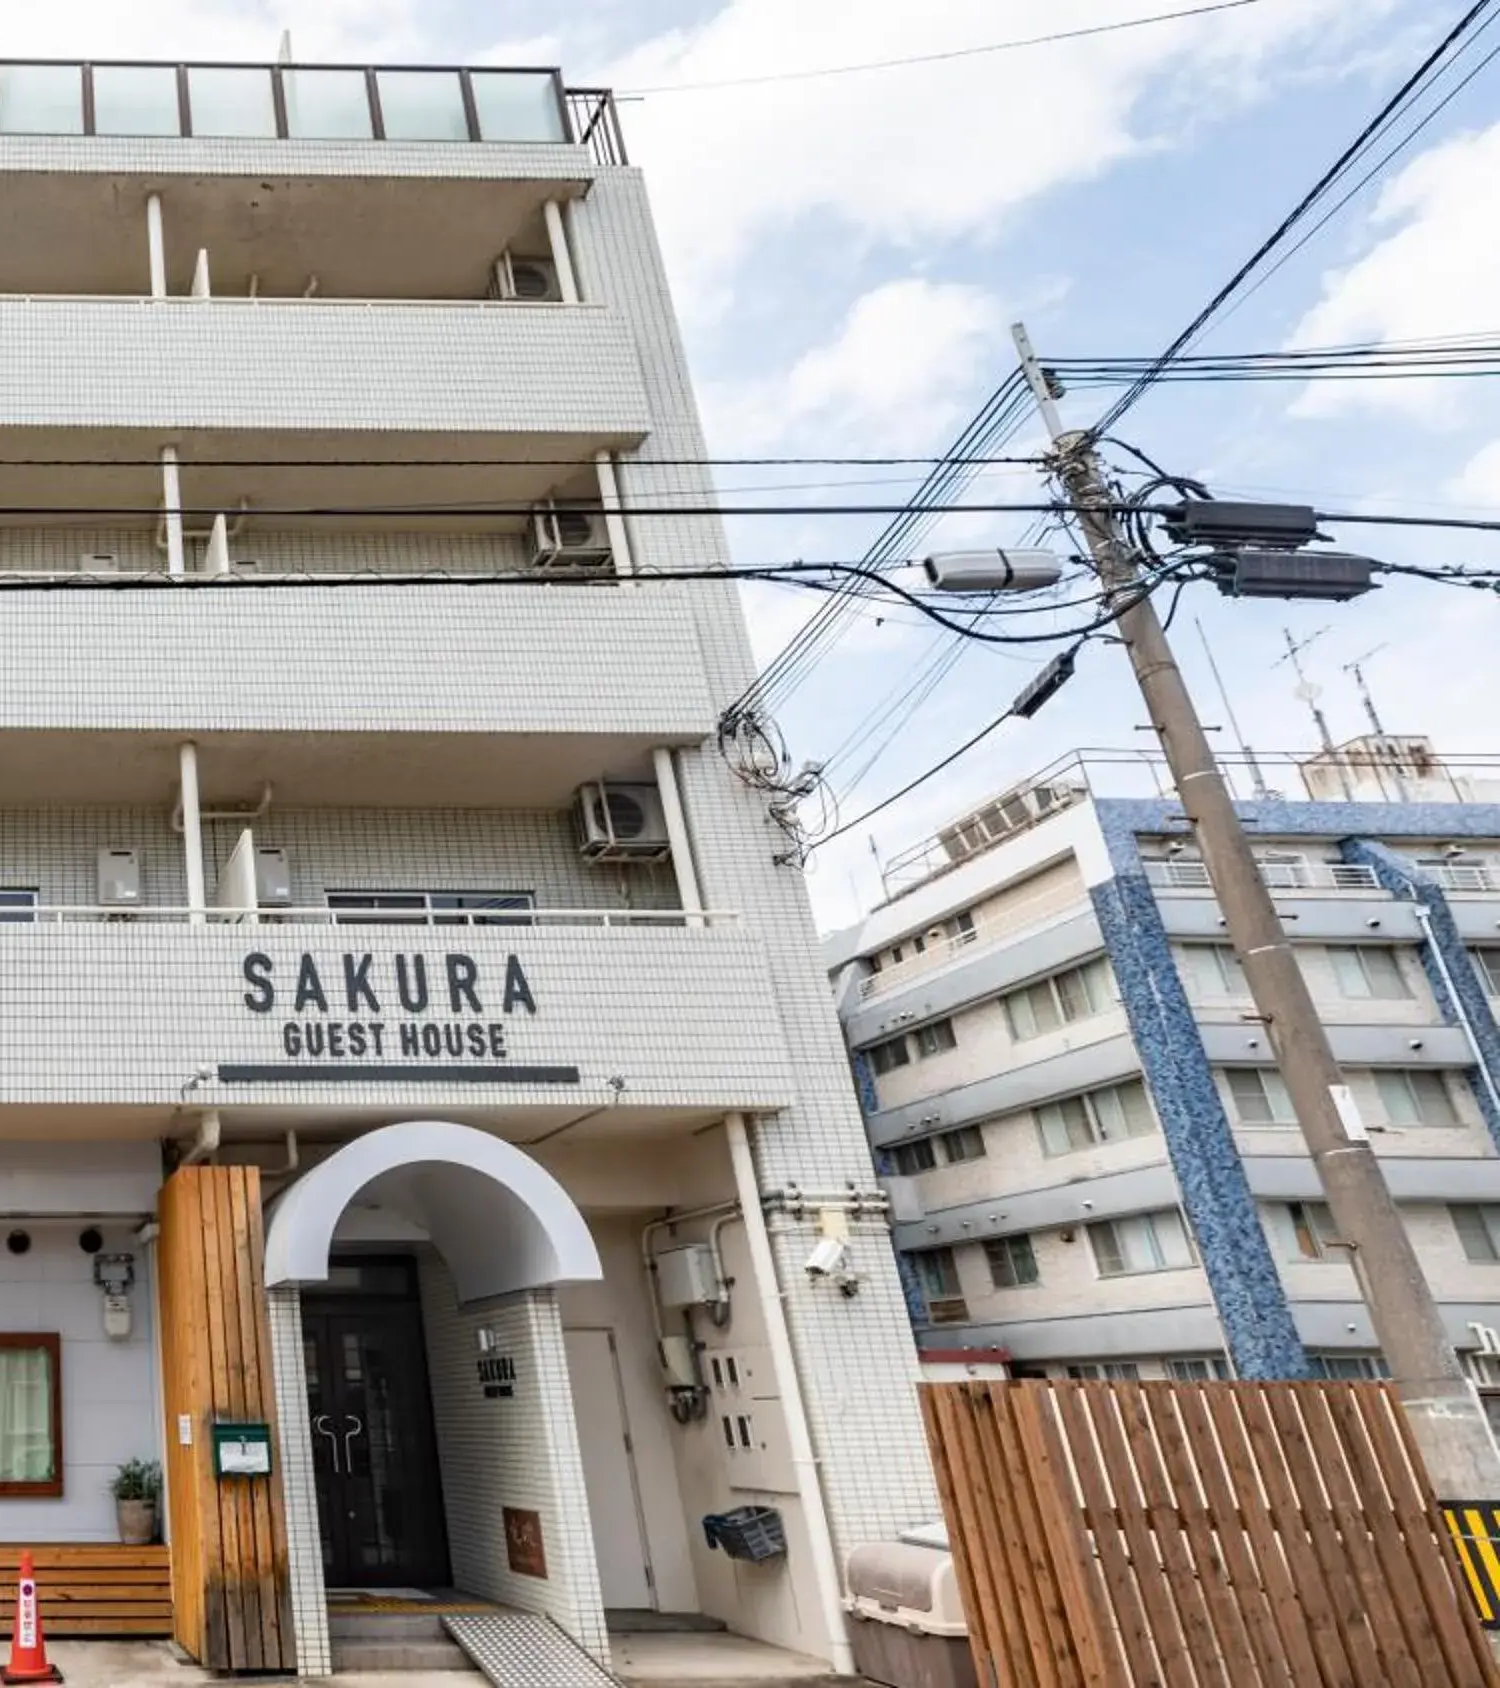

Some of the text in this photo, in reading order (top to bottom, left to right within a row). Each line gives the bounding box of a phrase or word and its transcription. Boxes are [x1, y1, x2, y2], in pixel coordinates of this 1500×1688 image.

[243, 951, 537, 1015] SAKURA
[283, 1021, 507, 1058] GUEST HOUSE
